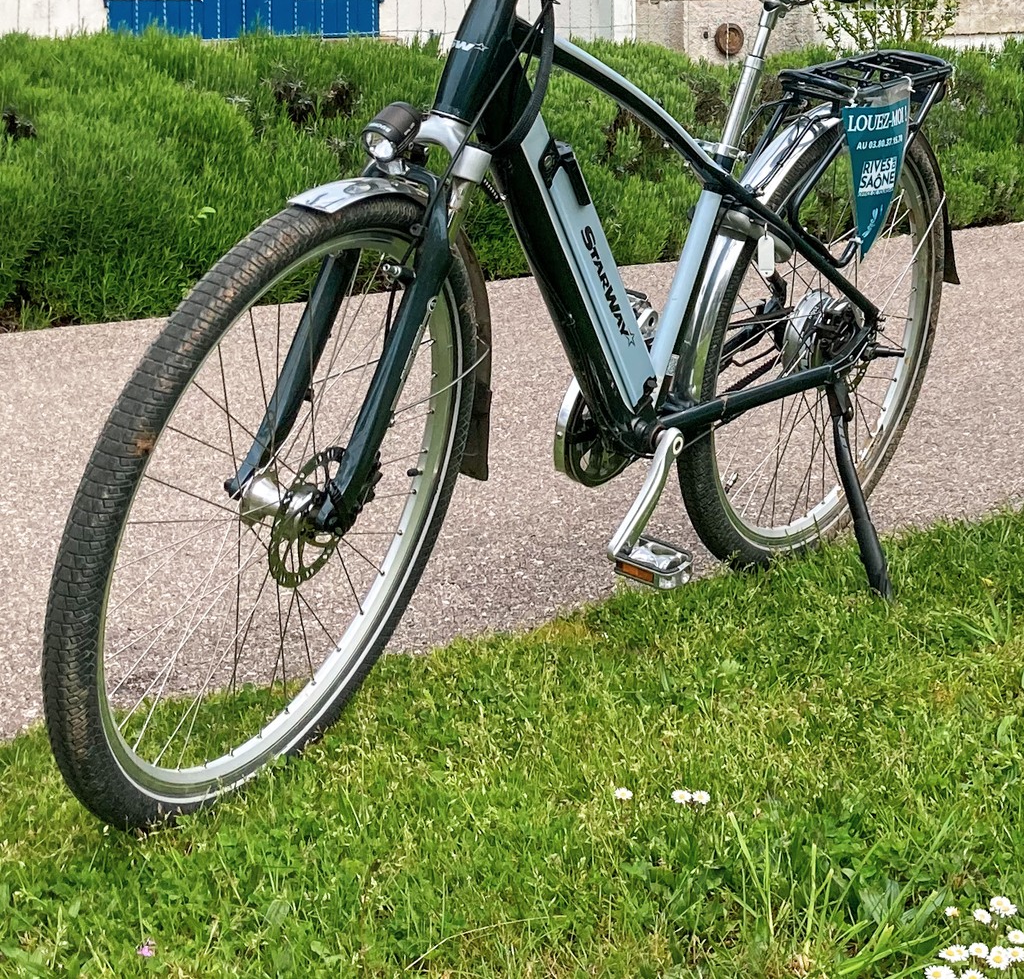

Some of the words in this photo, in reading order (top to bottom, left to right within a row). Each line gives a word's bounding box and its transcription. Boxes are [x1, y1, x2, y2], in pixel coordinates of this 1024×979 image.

[856, 141, 868, 150] AU
[863, 158, 891, 174] RIVES
[860, 171, 895, 189] SAÔNE
[581, 225, 631, 337] STARWAY
